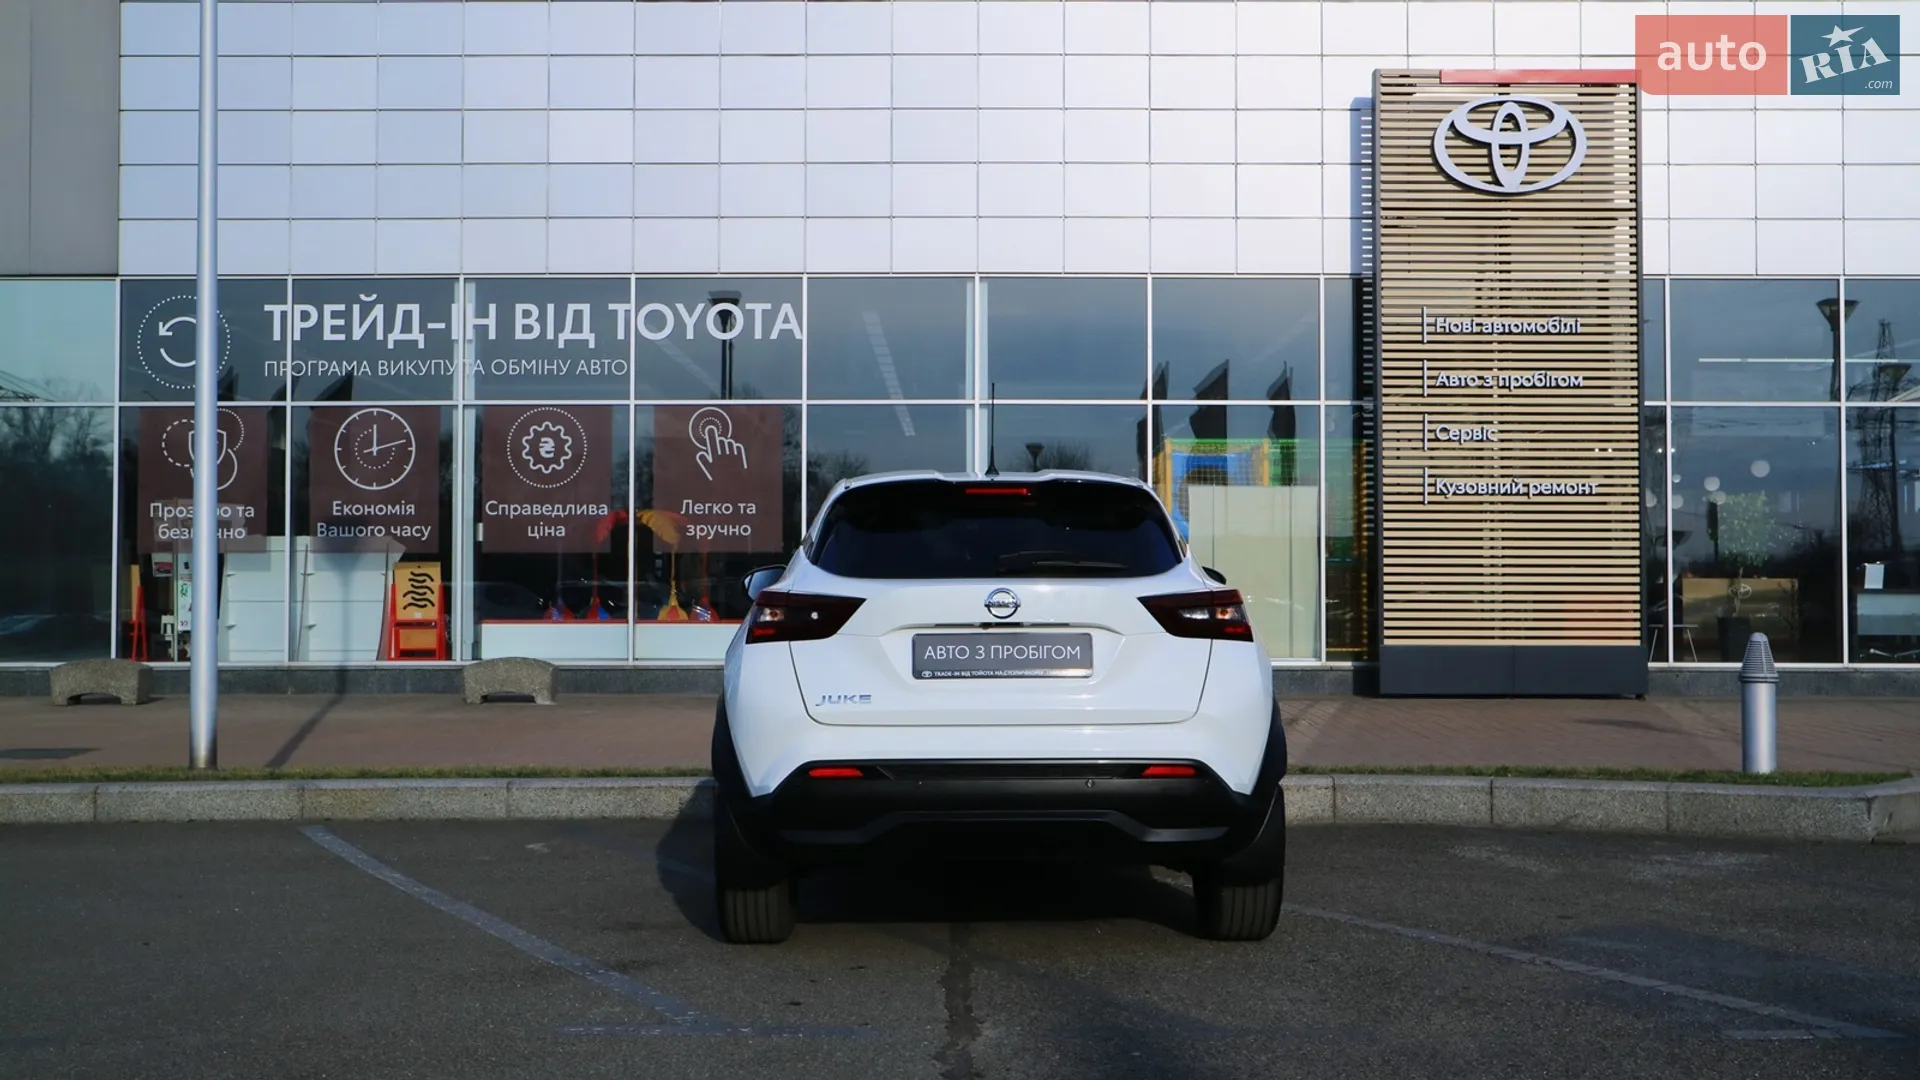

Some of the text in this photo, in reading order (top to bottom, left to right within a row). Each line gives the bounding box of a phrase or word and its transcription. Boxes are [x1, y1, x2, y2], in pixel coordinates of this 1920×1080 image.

[264, 293, 803, 349] ТРЕЙД-ІН ВІД TOYOTA
[1434, 316, 1582, 334] Нові автомобілі
[264, 360, 371, 377] ПРОГРАМА
[379, 359, 458, 377] ВИКУПУ
[491, 359, 571, 376] ОБМІНУ
[576, 359, 628, 376] АВТО
[1435, 371, 1584, 391] Авто з пробігом
[1434, 424, 1499, 445] Сервіс
[1434, 477, 1599, 498] Кузовний ремонт
[149, 502, 255, 521] Прозо та
[332, 500, 415, 516] Економія
[485, 500, 609, 519] Справедлива
[680, 499, 757, 515] Легко та
[316, 522, 431, 541] Вашого часу
[527, 521, 566, 538] ціна
[686, 524, 752, 541] зручно
[924, 645, 970, 660] АВТО
[990, 644, 1081, 660] ПРОБІГОМ
[814, 694, 872, 707] JUKE
